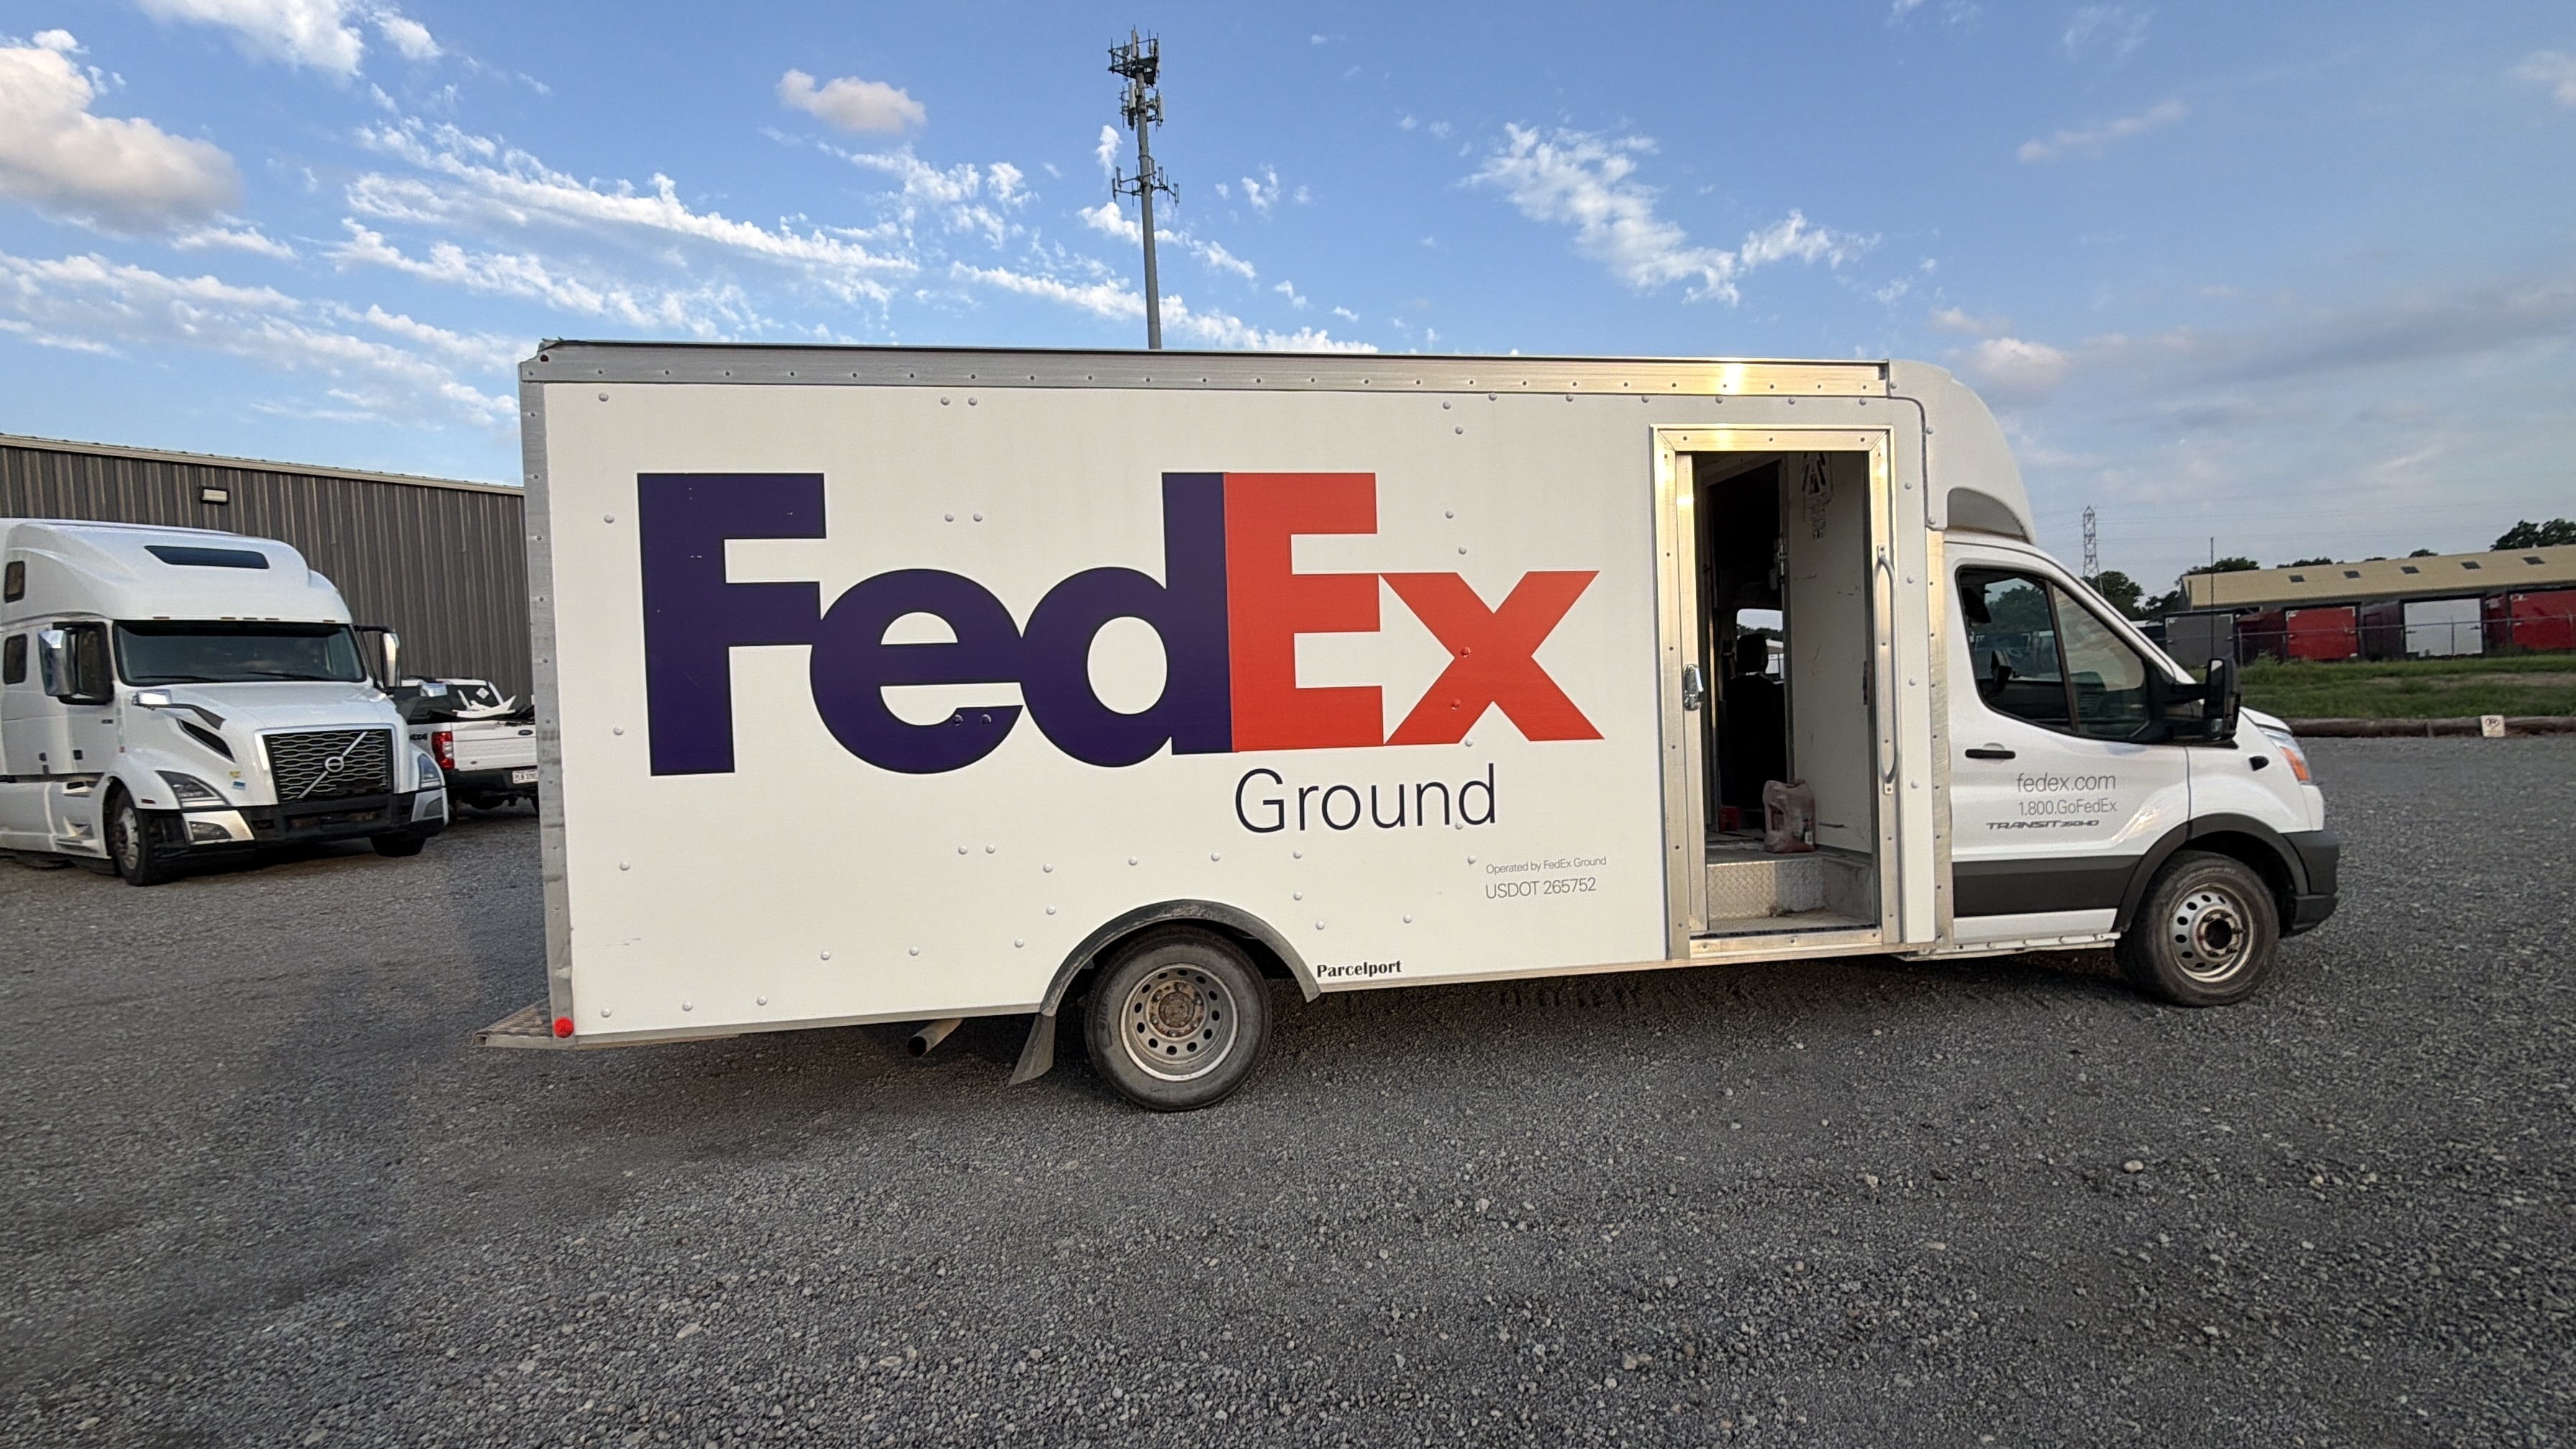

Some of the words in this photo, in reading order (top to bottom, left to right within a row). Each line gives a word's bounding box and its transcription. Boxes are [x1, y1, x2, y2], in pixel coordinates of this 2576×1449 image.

[638, 473, 1605, 776] FedEx
[2016, 772, 2117, 793] fedex.com
[1235, 763, 1496, 833] Ground
[2018, 798, 2118, 816] 1.800.GoFedEx
[1987, 820, 2061, 830] TRANSIT
[1486, 862, 1528, 876] Operated
[1530, 861, 1541, 872] by
[1543, 858, 1572, 870] FedEx
[1574, 856, 1607, 868] Ground
[1485, 881, 1540, 899] USDOT
[1543, 876, 1597, 895] 265752
[1317, 960, 1402, 978] Parcelport
